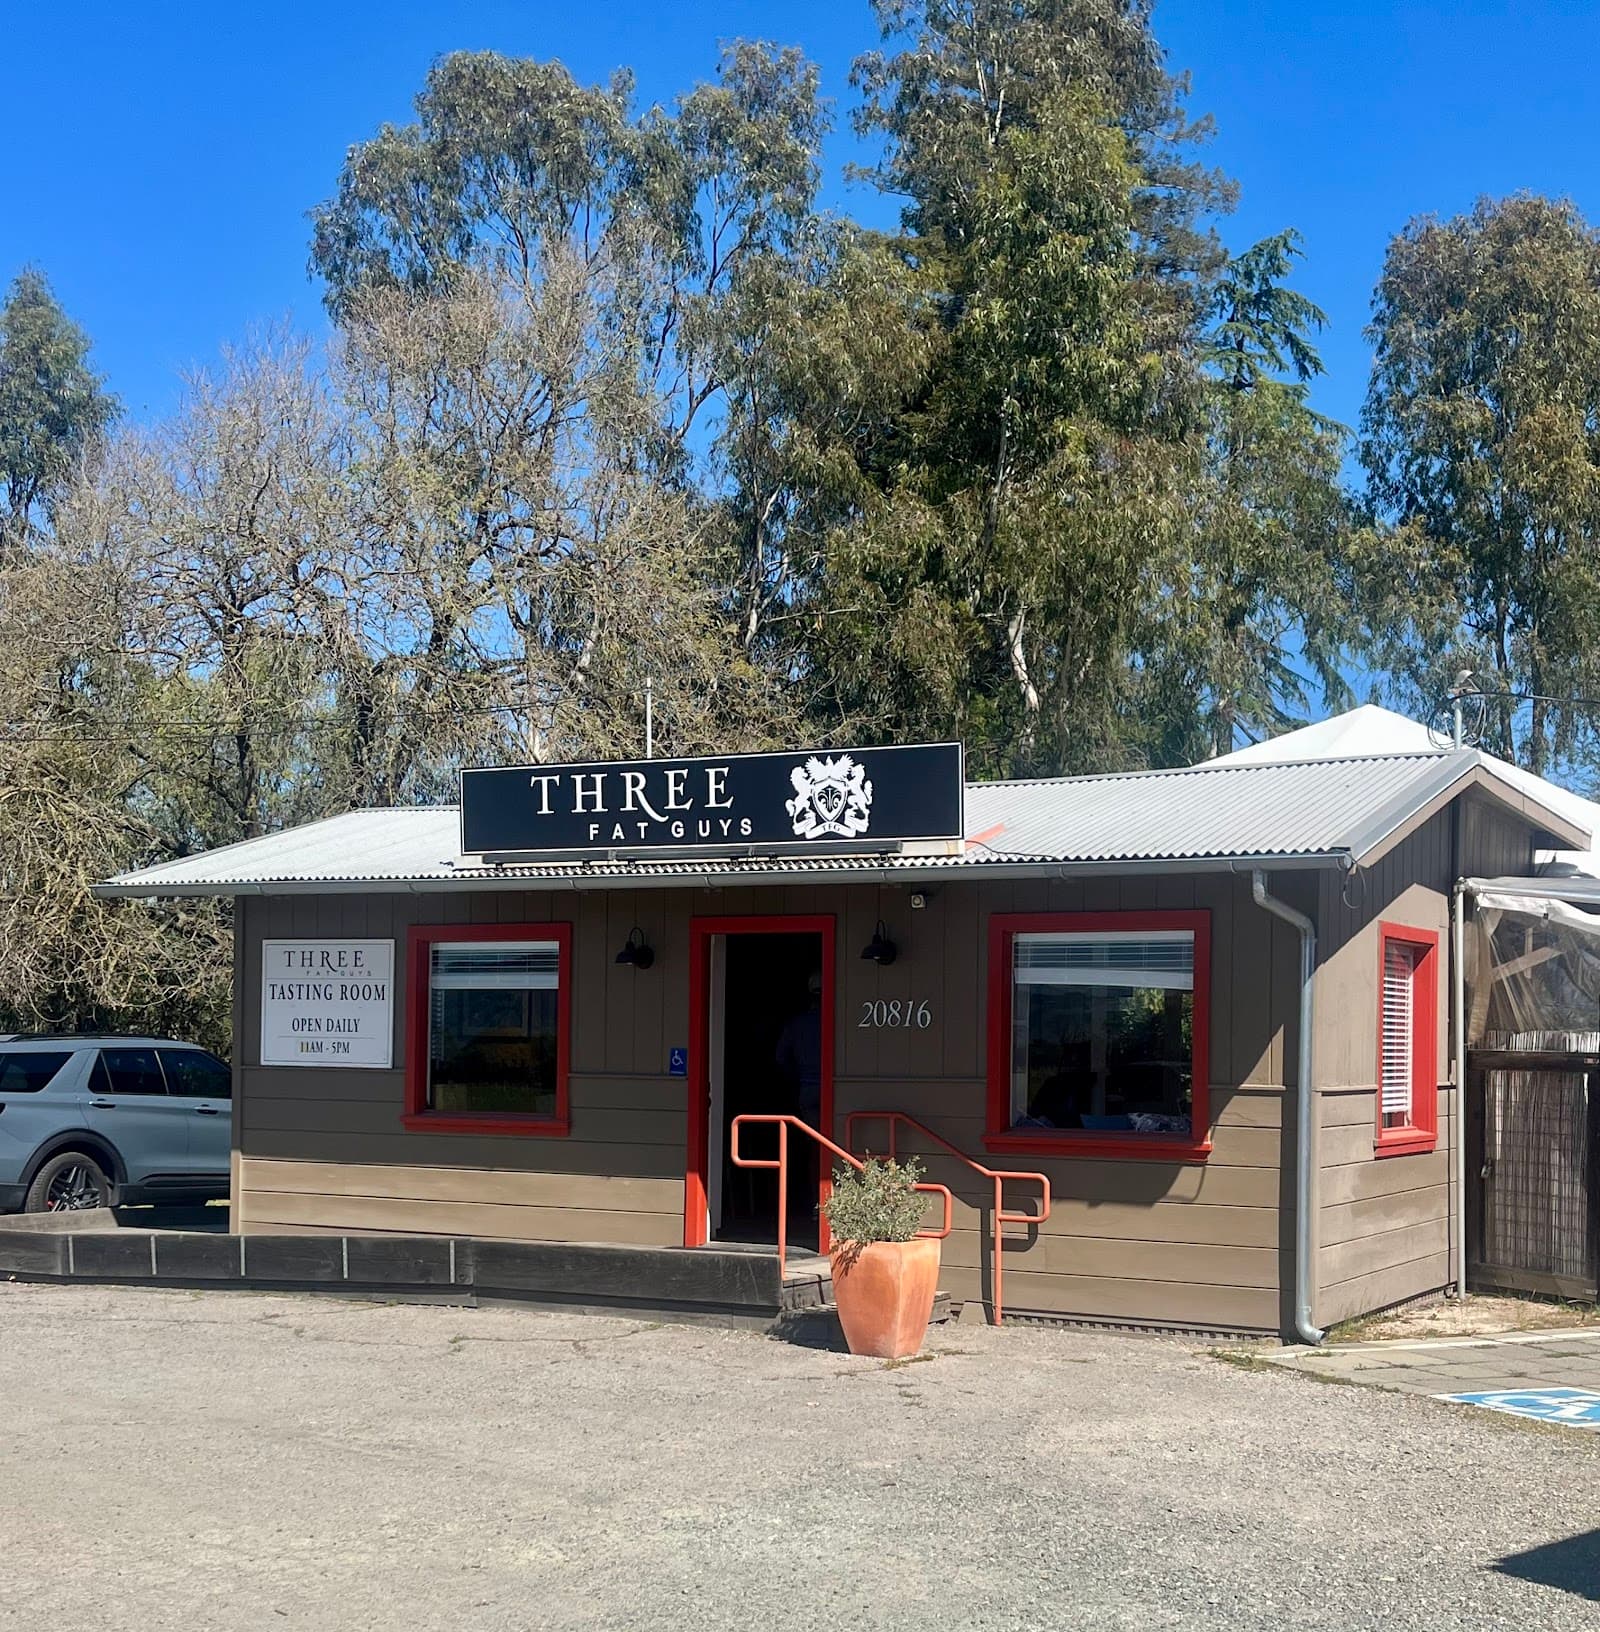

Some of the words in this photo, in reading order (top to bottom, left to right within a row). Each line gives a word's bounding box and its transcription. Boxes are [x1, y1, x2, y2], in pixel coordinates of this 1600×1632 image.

[530, 766, 735, 822] THREE
[588, 821, 651, 841] FAT
[671, 819, 753, 838] GUYS
[822, 822, 841, 832] TFG
[283, 950, 365, 972] THREE
[269, 983, 333, 1001] TASTING
[340, 984, 386, 1001] ROOM
[858, 999, 932, 1029] 20816
[291, 1017, 322, 1032] OPEN
[326, 1018, 361, 1033] DAILY
[300, 1041, 323, 1053] 11AM
[331, 1041, 350, 1054] 5PM
